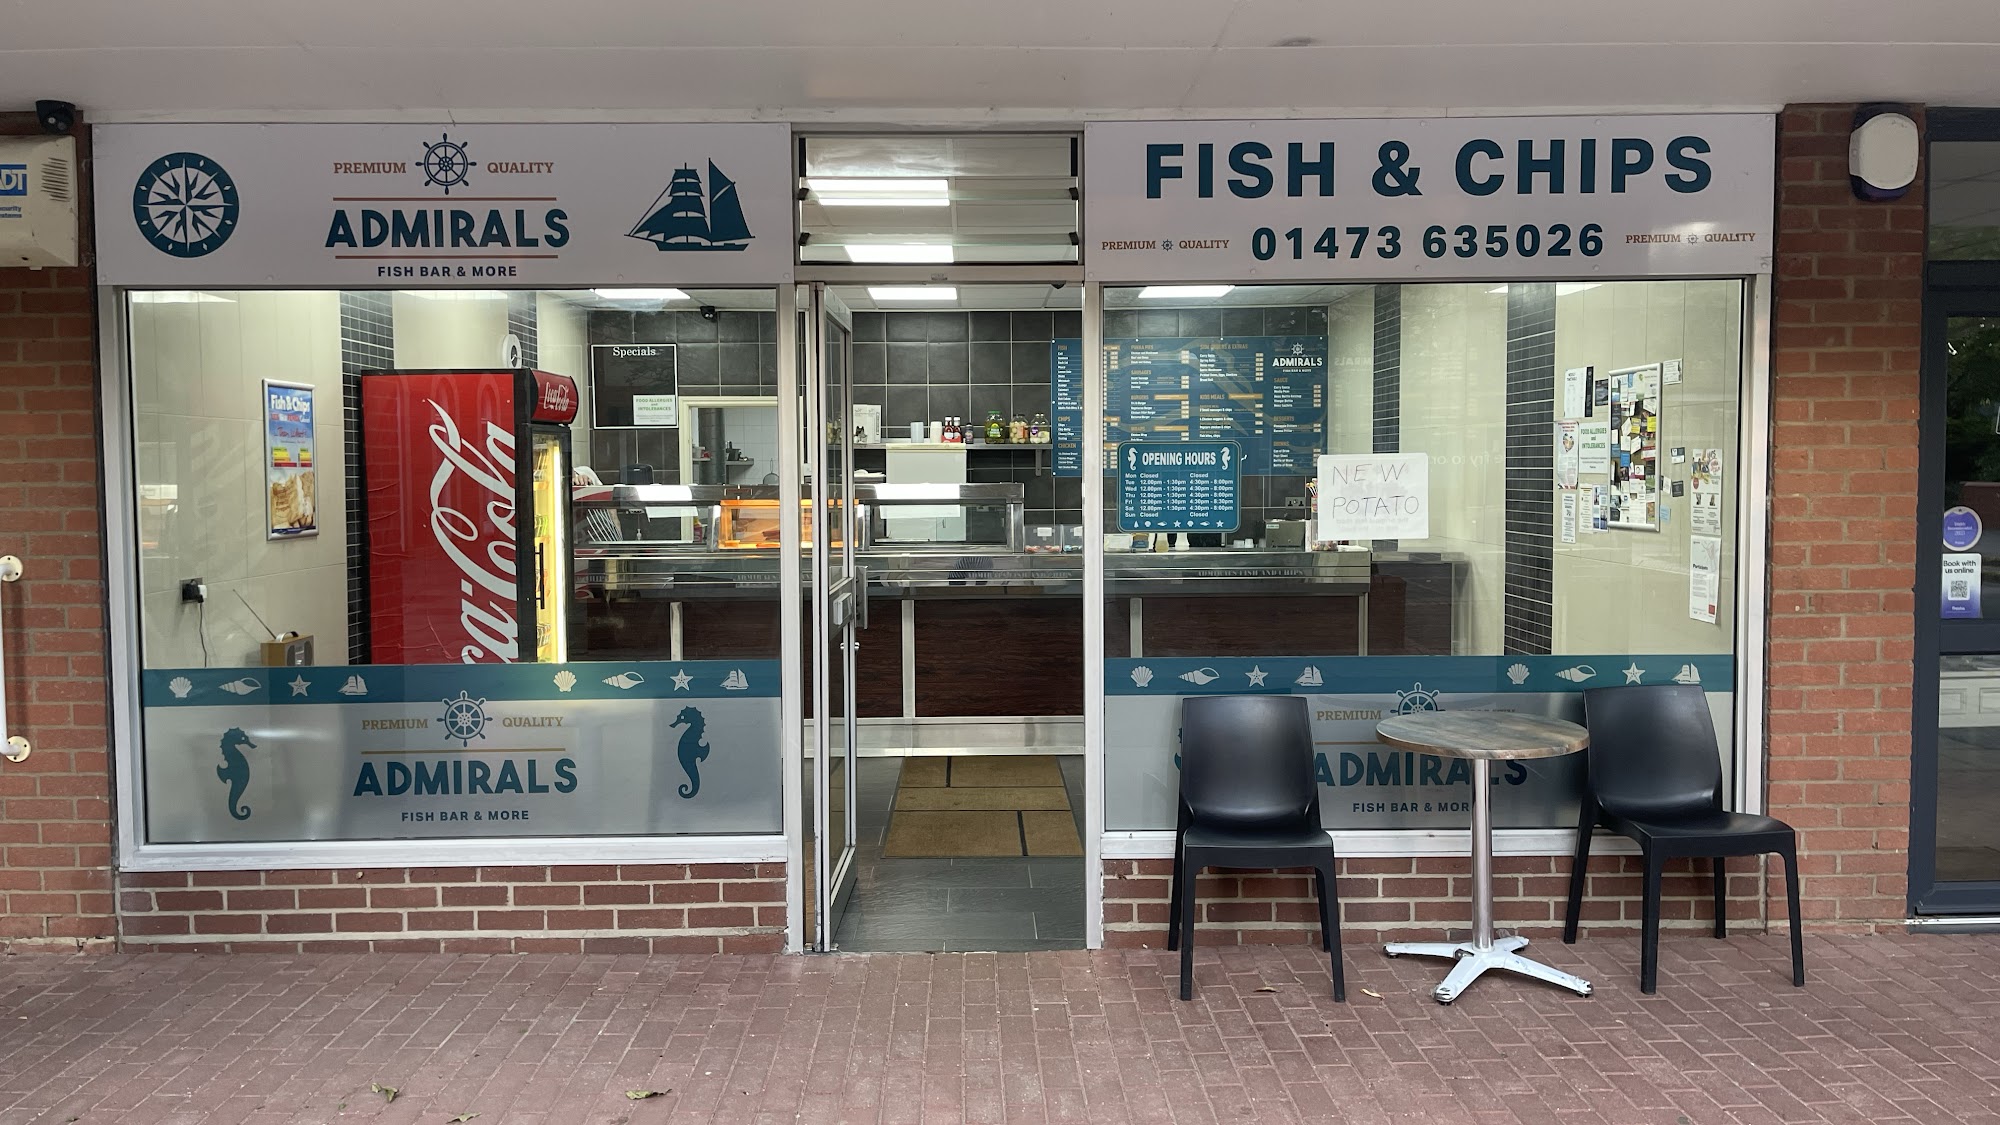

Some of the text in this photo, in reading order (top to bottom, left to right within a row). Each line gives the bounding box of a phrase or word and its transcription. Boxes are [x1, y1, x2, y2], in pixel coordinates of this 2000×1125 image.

[333, 161, 554, 174] PREMIUM QUALITY
[1146, 136, 1712, 199] FISH & CHIPS
[325, 209, 569, 248] ADMIRALS
[1101, 239, 1230, 251] PREMIUM QUALITY
[1252, 223, 1604, 261] 01473 635026
[1624, 232, 1756, 245] PREMIUM QUALITY
[378, 265, 517, 278] FISH BAR & MORE
[613, 346, 656, 358] Specials
[1272, 357, 1323, 367] ADMIRALS
[271, 395, 285, 410] Fish
[1142, 452, 1216, 465] OPENING HOURS
[1332, 462, 1406, 485] NEW
[1332, 496, 1419, 519] POTATO
[1316, 709, 1382, 722] PREMIUM
[362, 716, 563, 731] PREMIUM QUALITY
[1314, 752, 1528, 787] ADMIRAS
[353, 758, 578, 797] ADMIRALS
[1353, 801, 1470, 813] FISH BAR & MOR
[401, 809, 529, 822] FISH BAR & MORE
